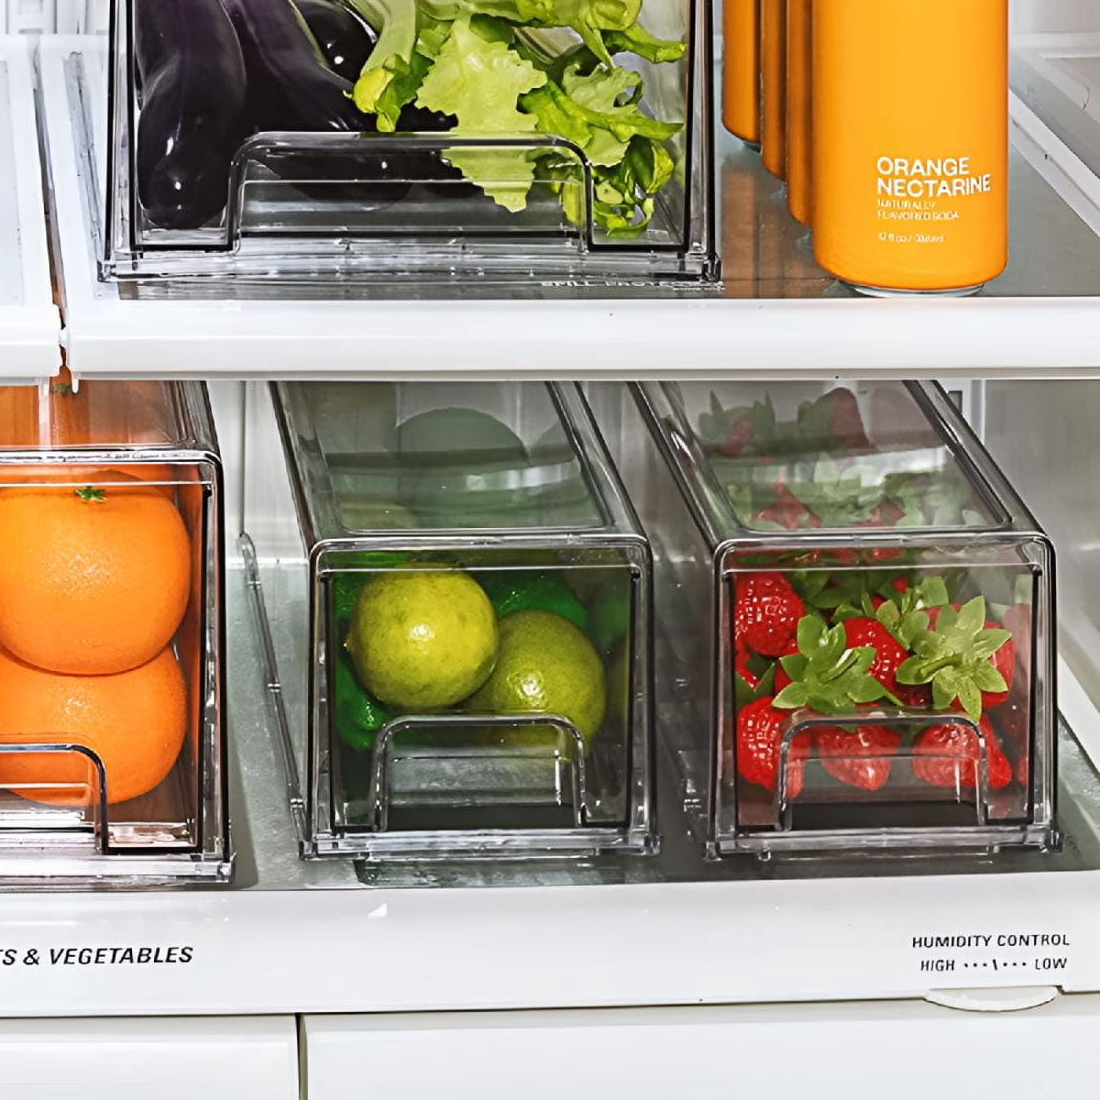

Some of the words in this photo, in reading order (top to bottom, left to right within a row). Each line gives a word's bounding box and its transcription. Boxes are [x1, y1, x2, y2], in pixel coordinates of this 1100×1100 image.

[877, 156, 970, 176] ORANGE
[877, 173, 992, 198] NECTARINE
[912, 934, 992, 948] HUMIDITY
[997, 934, 1070, 947] CONTROL
[22, 948, 40, 966] &
[50, 946, 194, 965] VEGETABLES
[920, 959, 955, 971] HIGH
[1035, 957, 1068, 970] LOW
